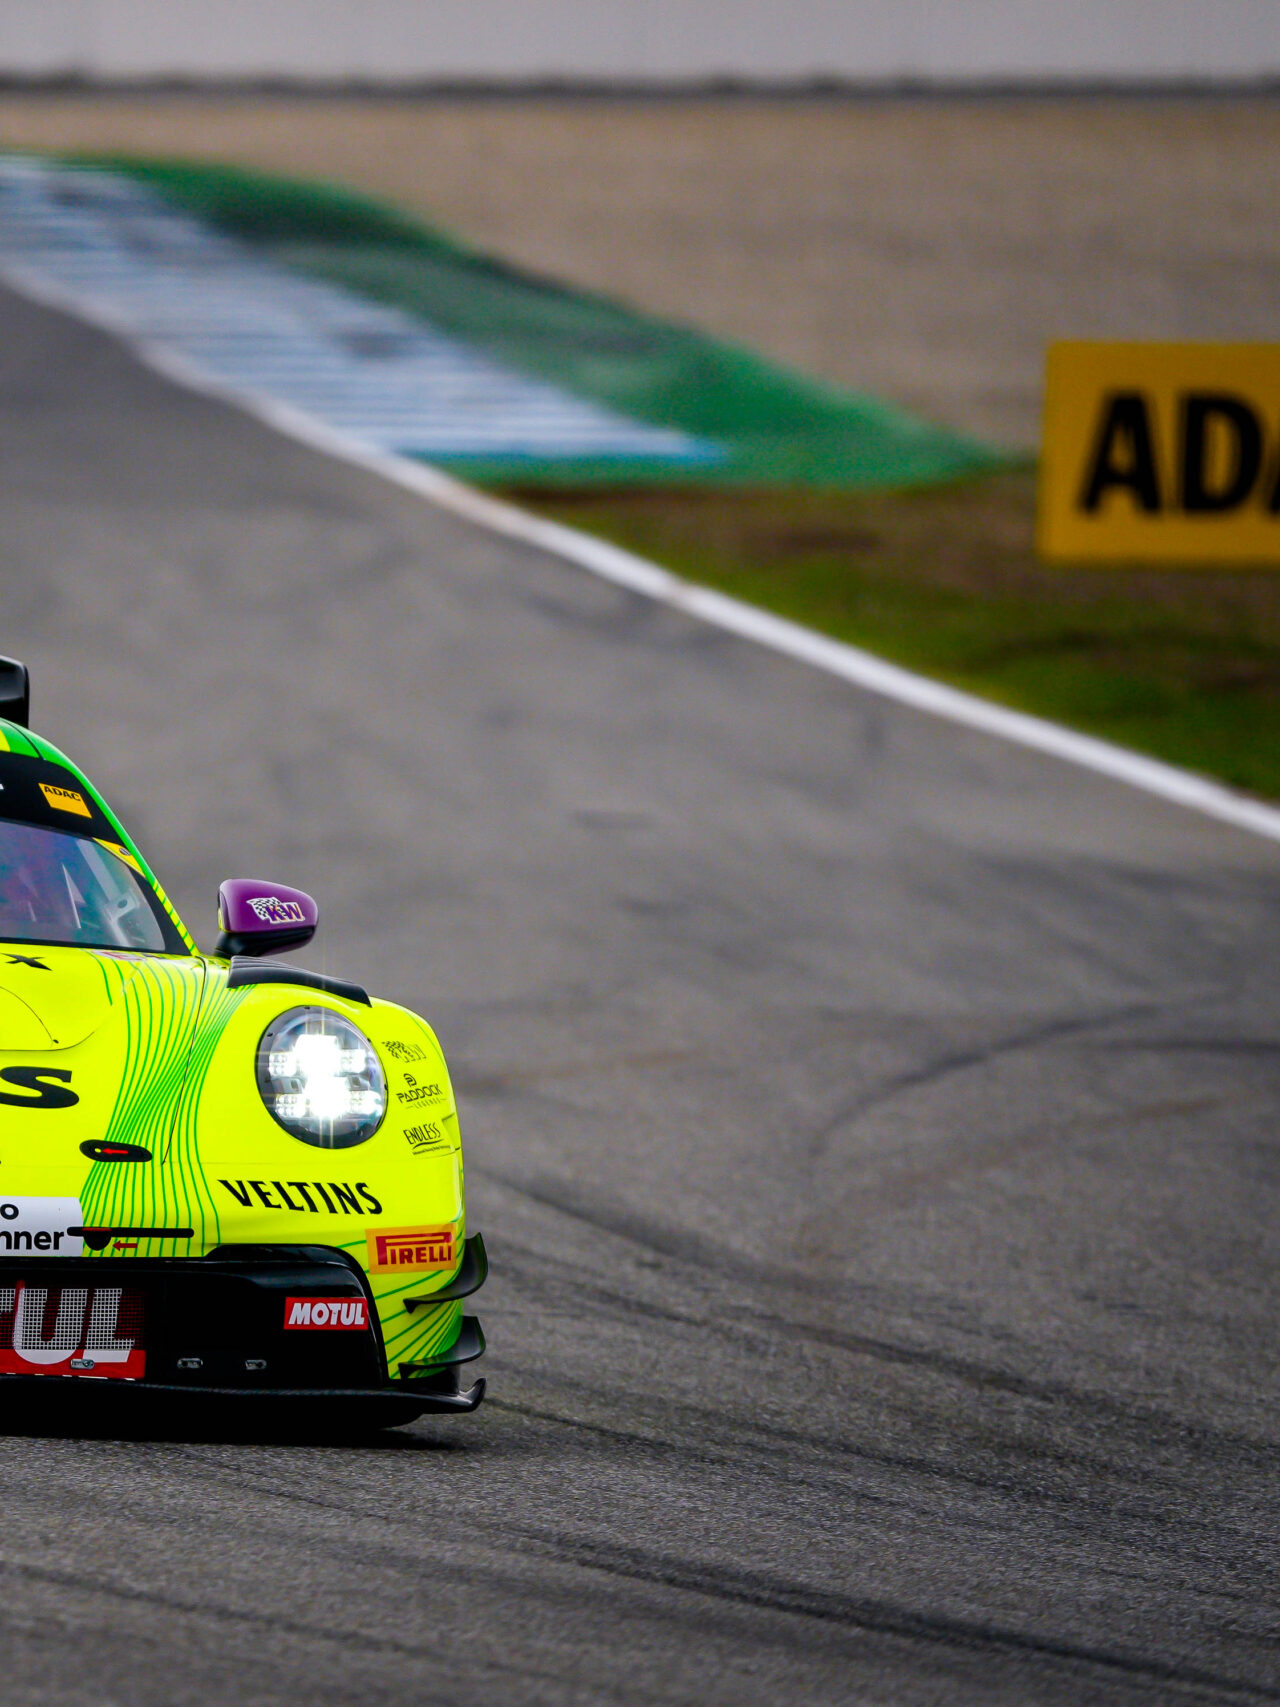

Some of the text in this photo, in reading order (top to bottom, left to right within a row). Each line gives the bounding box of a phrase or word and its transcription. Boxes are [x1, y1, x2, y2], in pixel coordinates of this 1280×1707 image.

[1076, 385, 1280, 517] AD
[42, 784, 82, 802] ADAC
[265, 901, 304, 924] KW
[395, 1083, 444, 1104] PADDOCK
[403, 1121, 442, 1145] ENDLESS
[216, 1179, 384, 1216] VELTINS
[375, 1230, 454, 1267] PIRELLI
[287, 1301, 366, 1326] MOTUL
